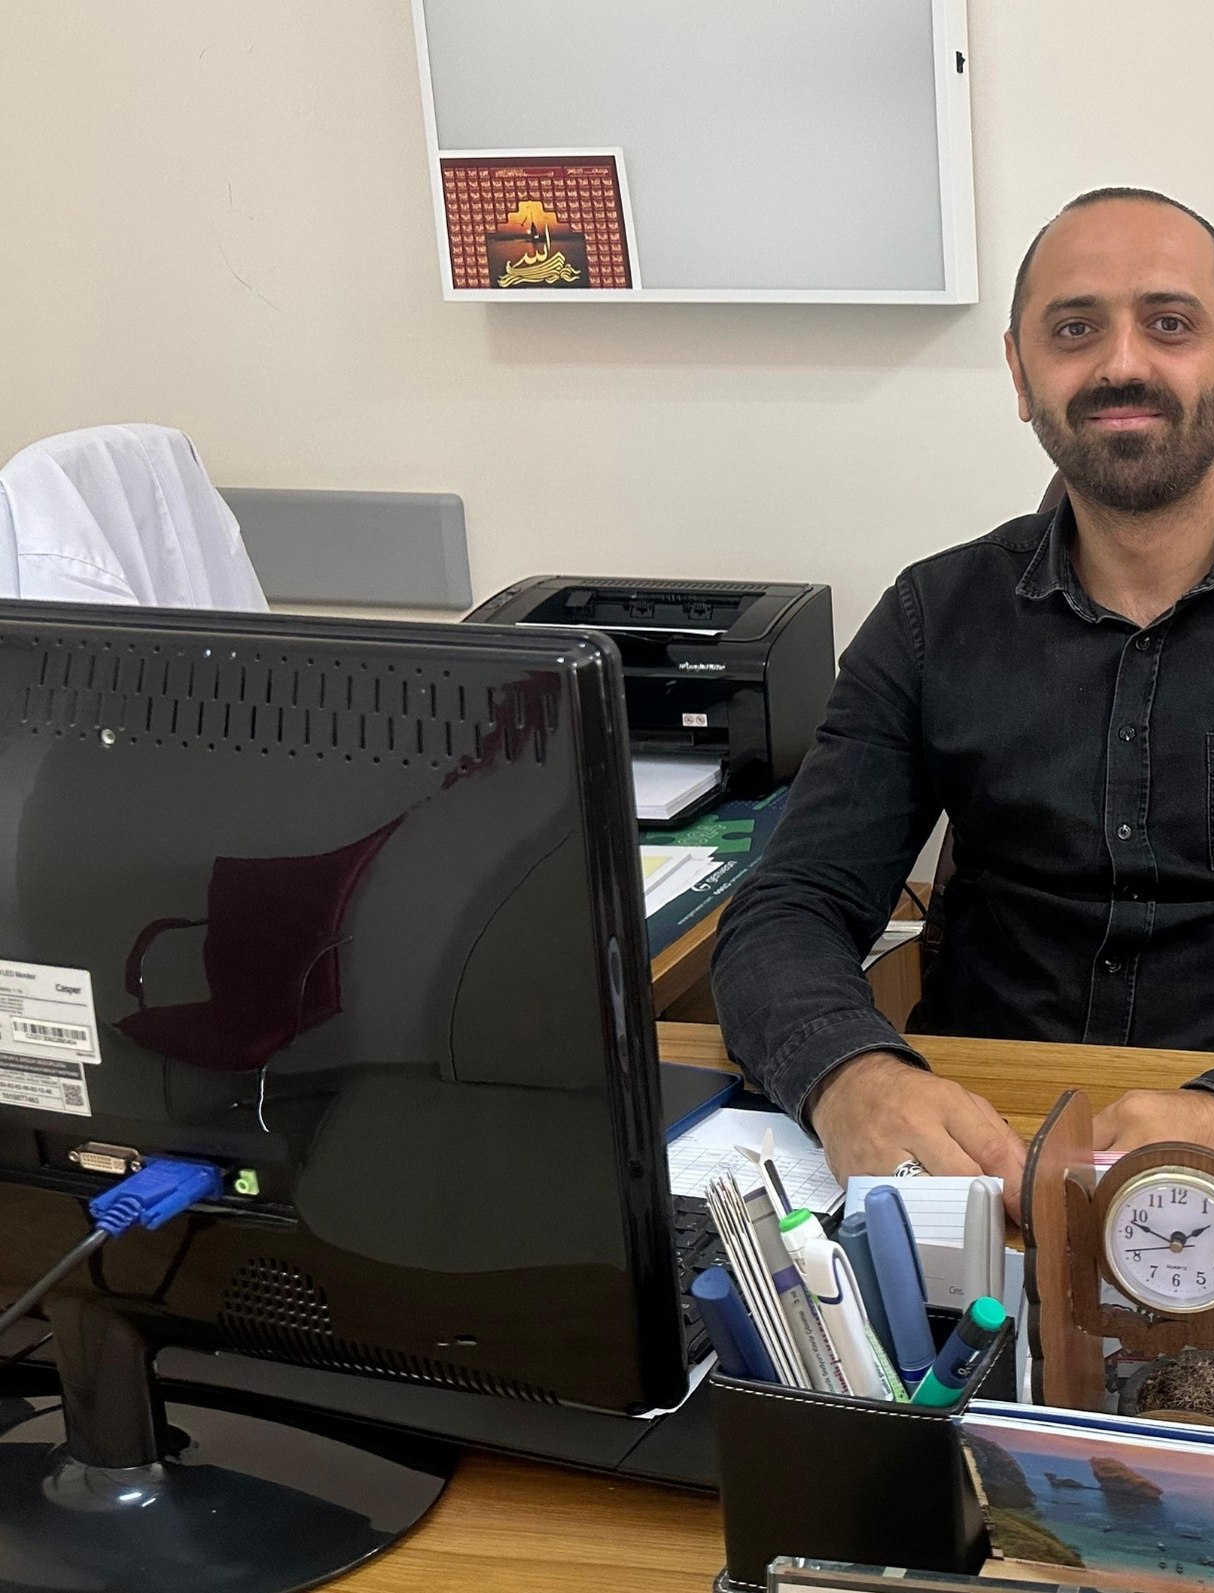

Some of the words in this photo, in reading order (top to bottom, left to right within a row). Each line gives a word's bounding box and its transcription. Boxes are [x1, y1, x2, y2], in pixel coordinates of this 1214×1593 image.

[55, 983, 81, 995] Casper
[1149, 1194, 1164, 1208] 11
[1170, 1188, 1188, 1205] 12
[1202, 1198, 1209, 1214] 1
[1132, 1209, 1148, 1223] 10
[1125, 1225, 1133, 1239] 9
[1132, 1251, 1142, 1262] 8
[1150, 1265, 1158, 1278] 7
[1196, 1272, 1206, 1285] 5
[1171, 1273, 1181, 1287] 6
